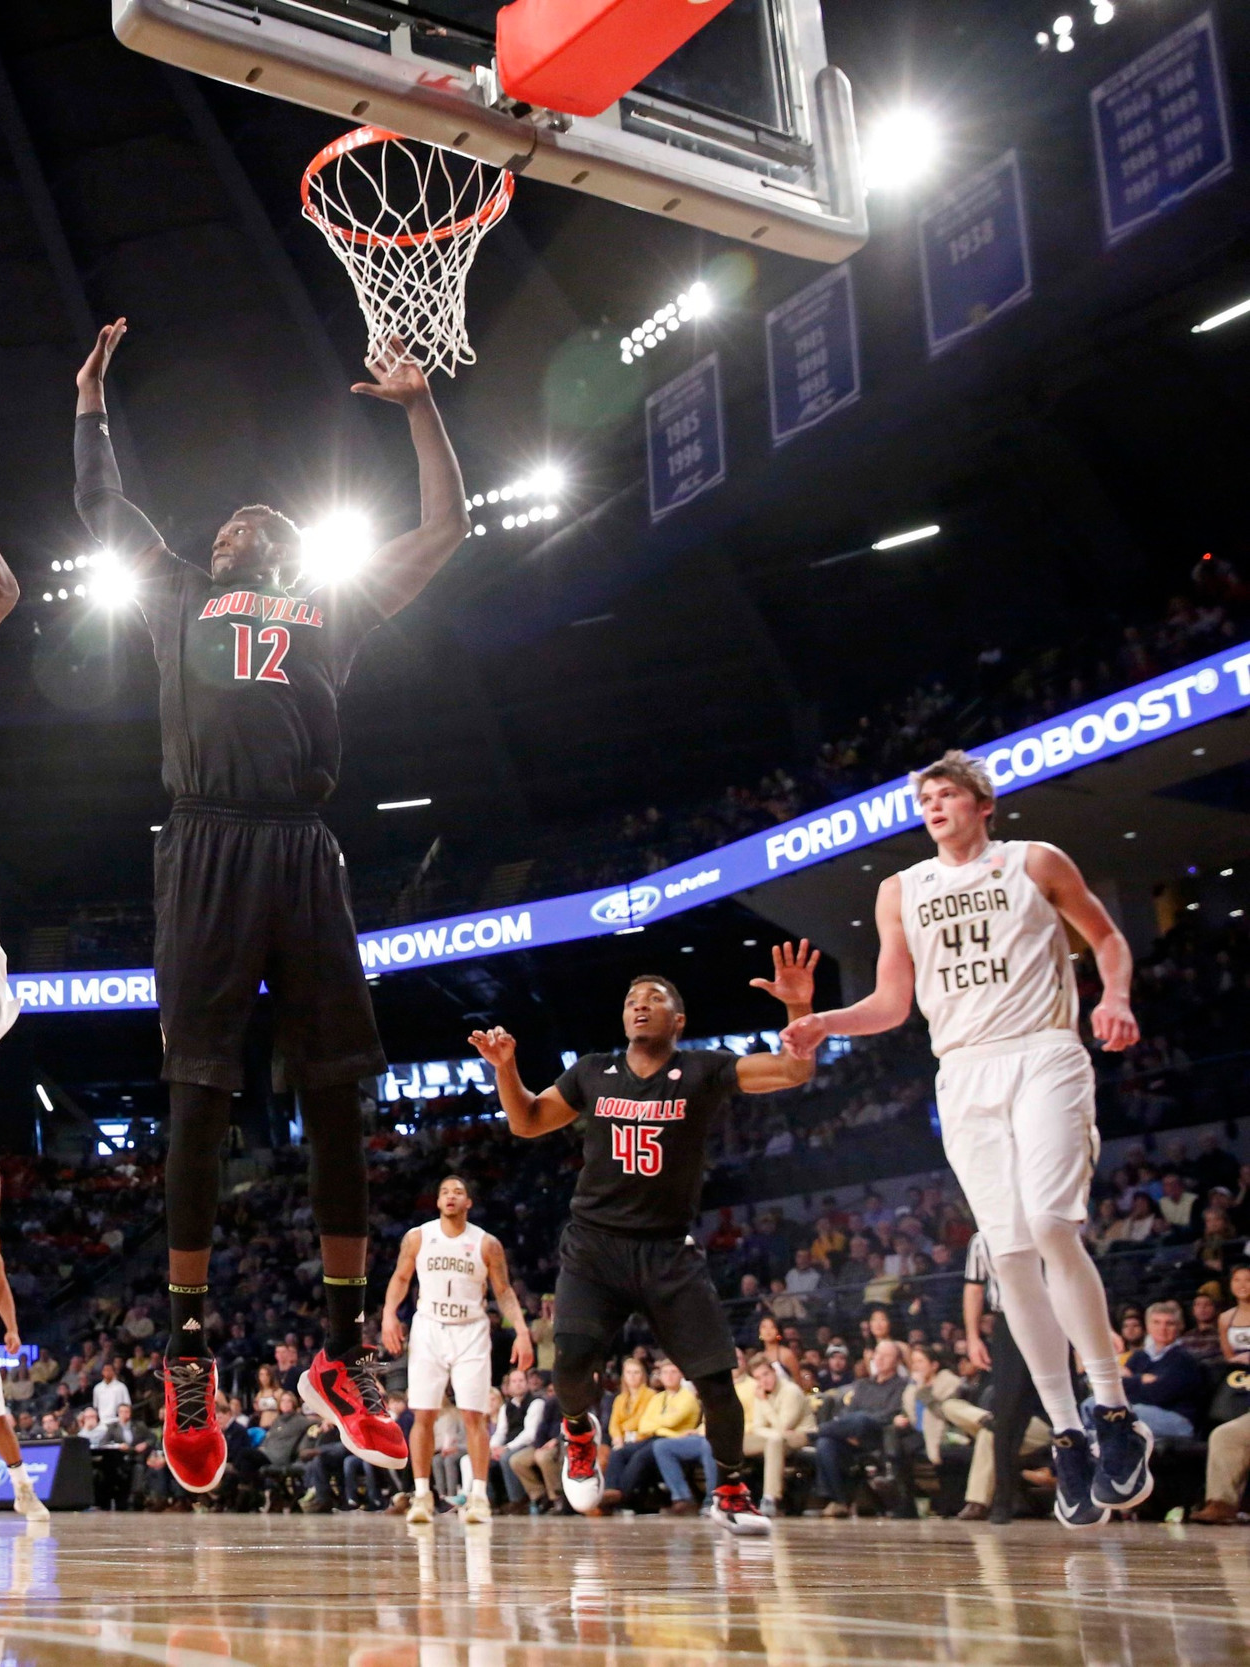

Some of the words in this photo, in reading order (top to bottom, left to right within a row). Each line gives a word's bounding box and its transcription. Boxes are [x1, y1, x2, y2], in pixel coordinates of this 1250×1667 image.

[198, 591, 323, 628] LOUISVILLE
[230, 622, 290, 685] 12
[766, 810, 858, 870] FORD
[858, 784, 925, 834] WIT
[918, 888, 1009, 927] GEORGIA
[941, 919, 990, 957] 44
[938, 958, 1009, 992] TECH
[594, 1097, 687, 1122] LOUISVILLE
[611, 1123, 664, 1177] 45
[427, 1256, 475, 1275] GEORGIA
[447, 1280, 452, 1297] 1
[432, 1301, 468, 1318] TECH
